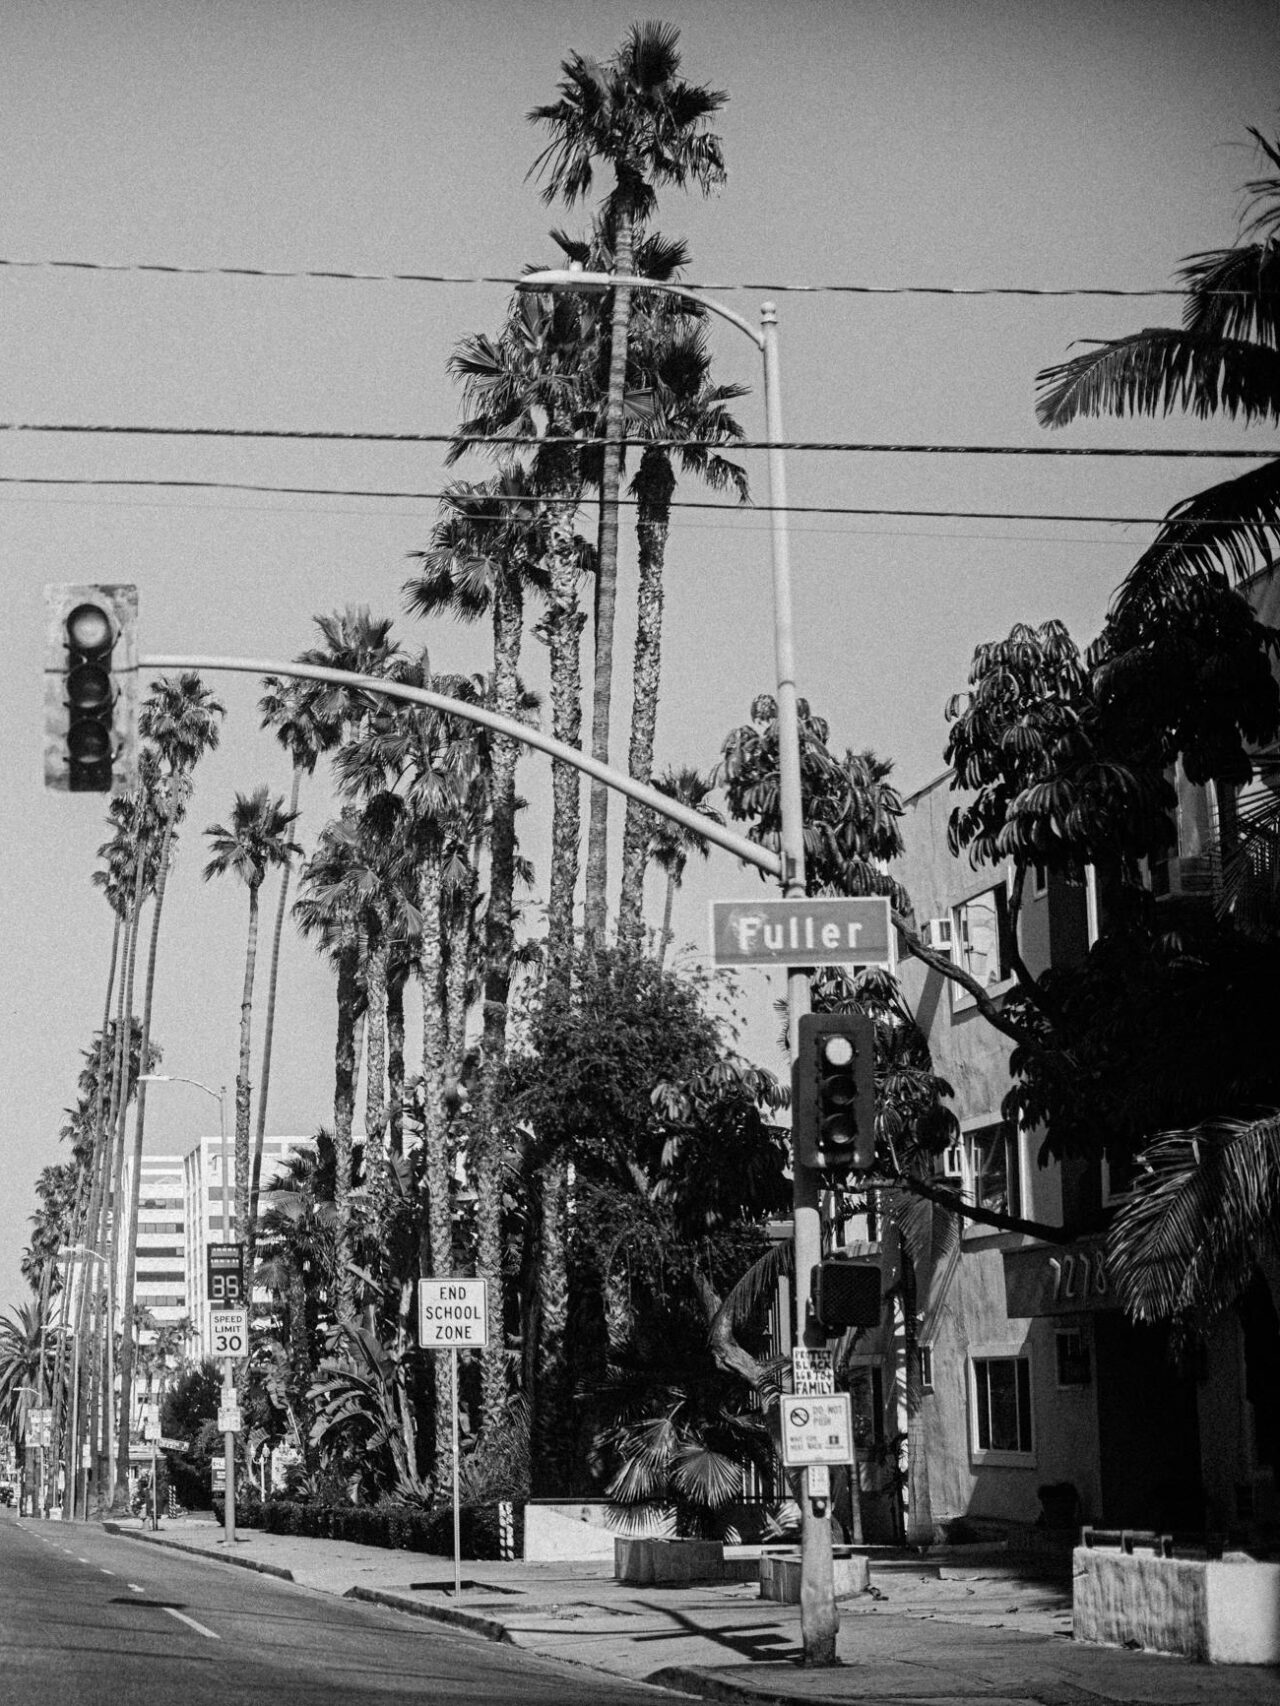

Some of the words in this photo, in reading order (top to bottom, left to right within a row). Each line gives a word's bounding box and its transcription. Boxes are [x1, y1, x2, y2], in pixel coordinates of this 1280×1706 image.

[738, 916, 862, 951] Fuller
[440, 1286, 467, 1300] END
[214, 1315, 242, 1323] SPEED
[426, 1306, 481, 1320] SCHOOL
[215, 1325, 241, 1333] LIMIT
[435, 1326, 472, 1340] ZONE
[216, 1335, 242, 1352] 30
[795, 1350, 832, 1360] PROTECT
[795, 1360, 832, 1370] BLACK
[795, 1381, 833, 1395] FAMILY
[827, 1404, 842, 1415] NOT
